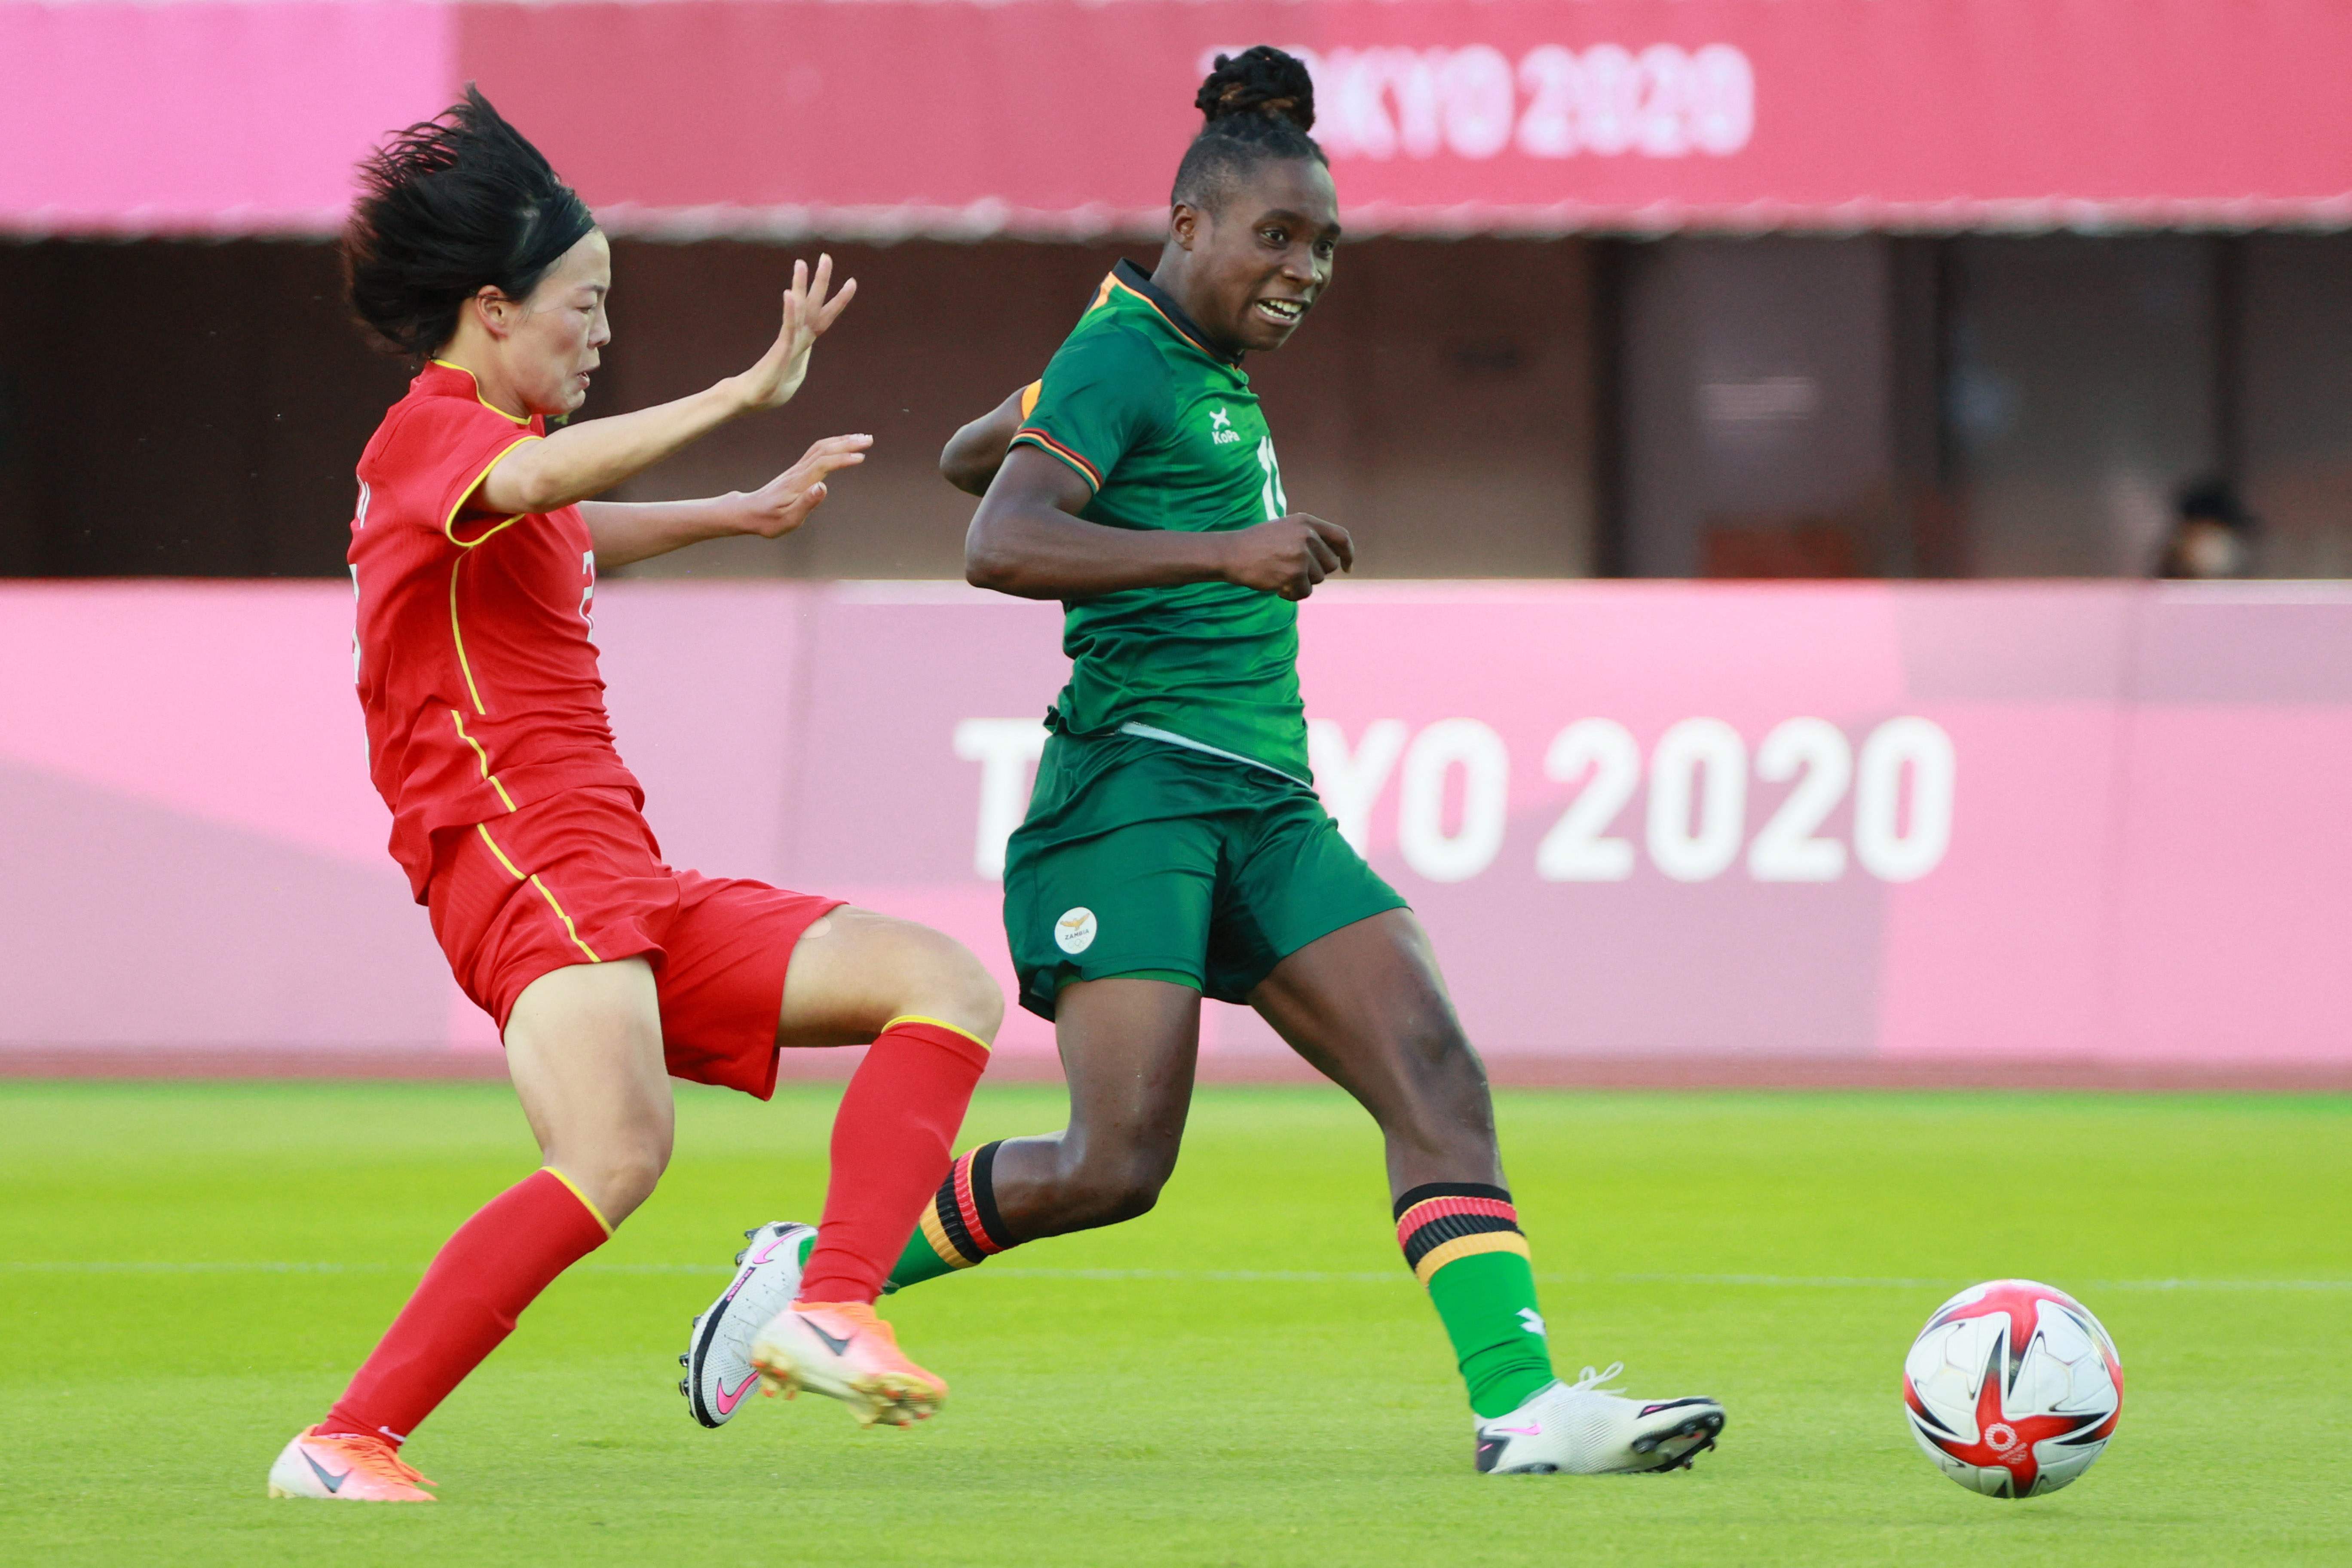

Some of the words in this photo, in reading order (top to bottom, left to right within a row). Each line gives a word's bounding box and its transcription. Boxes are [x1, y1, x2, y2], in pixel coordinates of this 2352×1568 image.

[1517, 44, 1753, 157] 2020
[953, 717, 1508, 883] TYO
[1537, 716, 1955, 883] 2020
[1065, 929, 1089, 940] ZAMBIA
